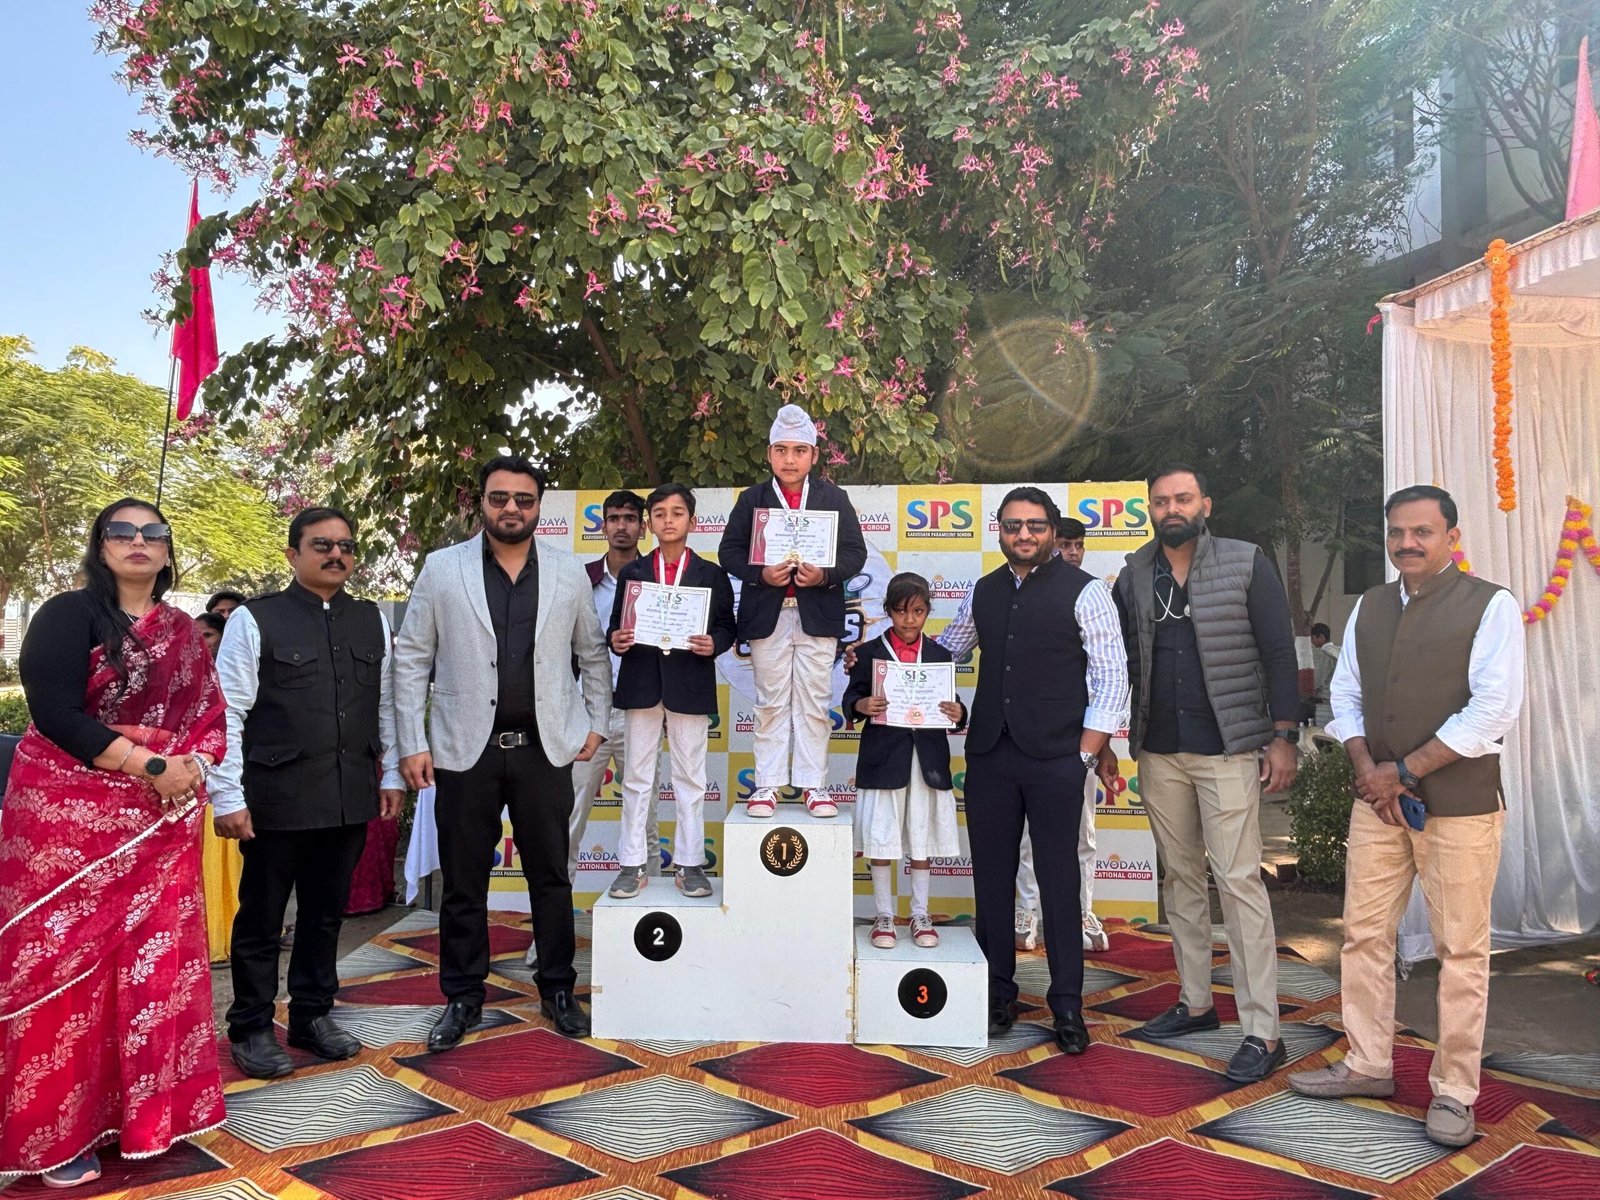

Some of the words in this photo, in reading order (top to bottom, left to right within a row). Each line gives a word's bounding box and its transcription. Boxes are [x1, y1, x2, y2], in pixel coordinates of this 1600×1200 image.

[583, 504, 603, 533] S
[860, 512, 890, 522] DAYA
[906, 500, 973, 530] SPS
[1078, 498, 1147, 529] SPS
[539, 516, 567, 526] DAYA
[697, 514, 726, 524] DAYA
[928, 580, 973, 590] VODAYA
[580, 851, 618, 861] RVODA
[781, 842, 787, 860] 1
[577, 862, 608, 870] CATIONAL
[1096, 860, 1151, 870] RVODAYA
[1094, 871, 1126, 879] CATIONAL
[1127, 872, 1152, 880] GROUP
[653, 927, 665, 946] 2
[916, 985, 928, 1004] 3
